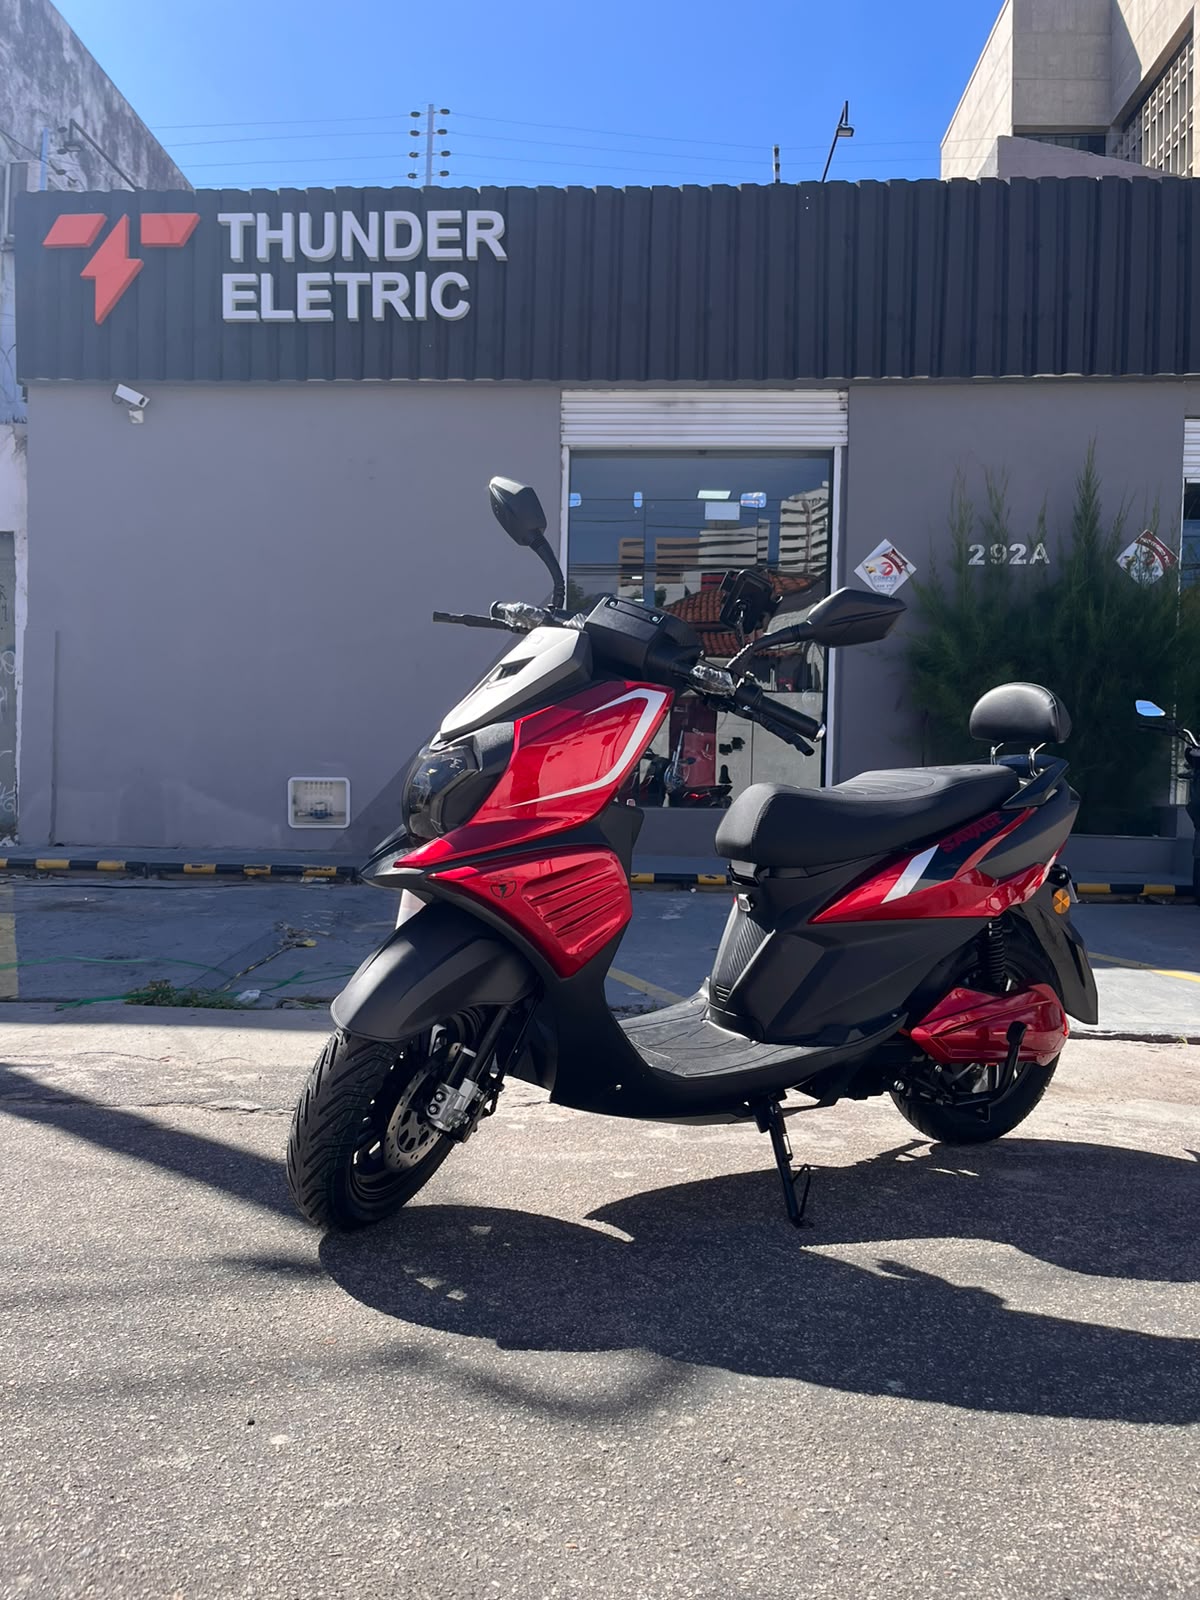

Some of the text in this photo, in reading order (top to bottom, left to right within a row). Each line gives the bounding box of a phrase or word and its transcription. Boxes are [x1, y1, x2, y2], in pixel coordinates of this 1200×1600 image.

[217, 209, 508, 263] THUNDER
[221, 271, 471, 322] ELETRIC
[968, 542, 1050, 565] 292A
